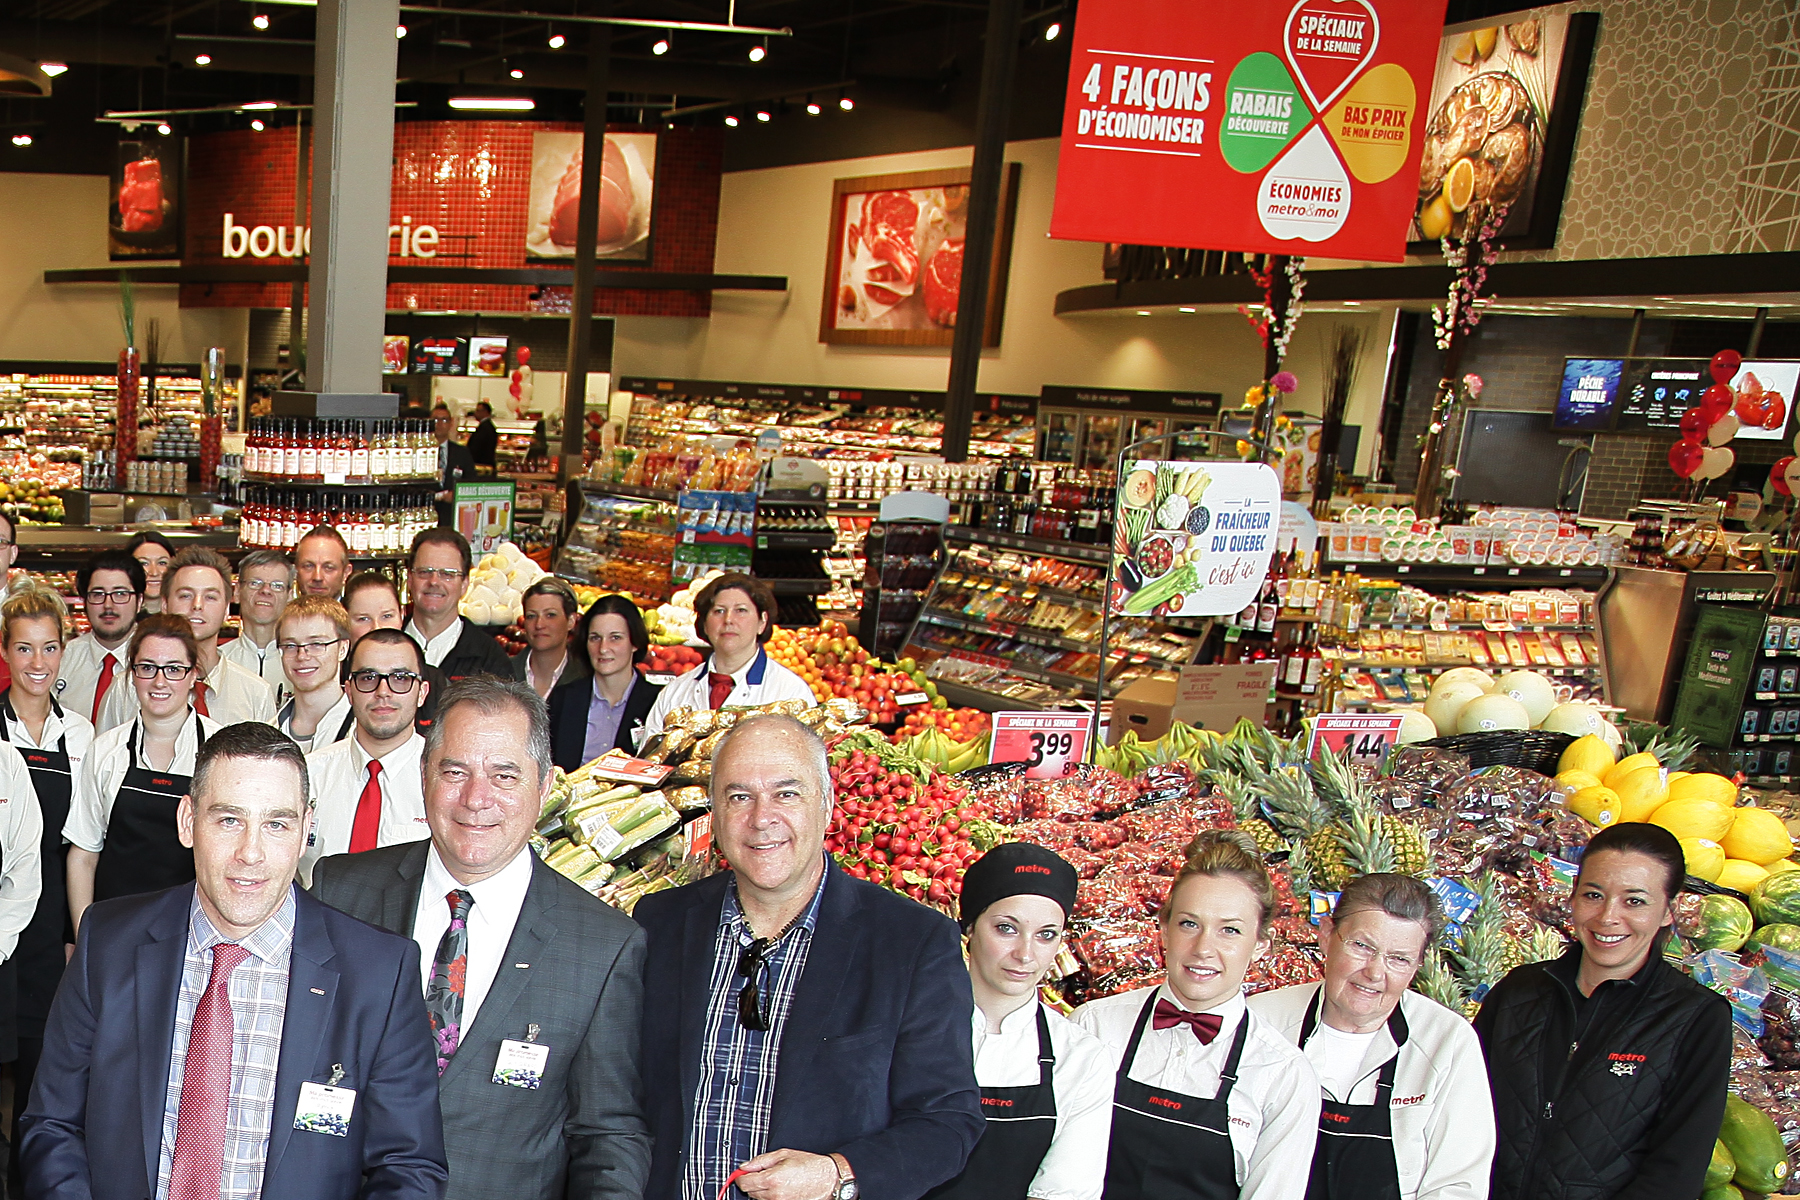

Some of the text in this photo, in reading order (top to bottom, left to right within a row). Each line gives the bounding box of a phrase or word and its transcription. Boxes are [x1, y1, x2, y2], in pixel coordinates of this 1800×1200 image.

[1298, 14, 1366, 40] SPÉCIAUX
[1297, 37, 1362, 55] DE LA SEMAINE
[1082, 63, 1212, 112] 4 FAÇONS
[1229, 92, 1293, 119] RABAIS
[1343, 106, 1407, 128] BAS PRIX
[1077, 105, 1205, 145] D'ÉCONOMISER
[1227, 115, 1290, 136] DÉCOUVERTE
[1342, 126, 1405, 141] DE MON ÉPICIER
[1269, 182, 1342, 203] ÉCONOMIES
[1578, 375, 1605, 390] PÊCHE
[1570, 390, 1607, 403] DURABLE
[1244, 498, 1252, 507] LA
[1214, 509, 1271, 529] FRAÎCHEUR
[1211, 532, 1267, 552] DU QUÉBEC
[1209, 556, 1256, 586] c'est ici
[1237, 681, 1269, 690] FRAGILE
[1008, 716, 1078, 728] SPÉCIAUX DE LA SEMAINE
[1326, 718, 1392, 728] SPÉCIAUX DE LA SEMAINE
[28, 754, 49, 763] metro
[152, 778, 173, 786] metro
[1014, 864, 1052, 875] metro
[1607, 1052, 1647, 1062] metro
[1147, 1095, 1183, 1110] metro
[1391, 1093, 1427, 1106] metro
